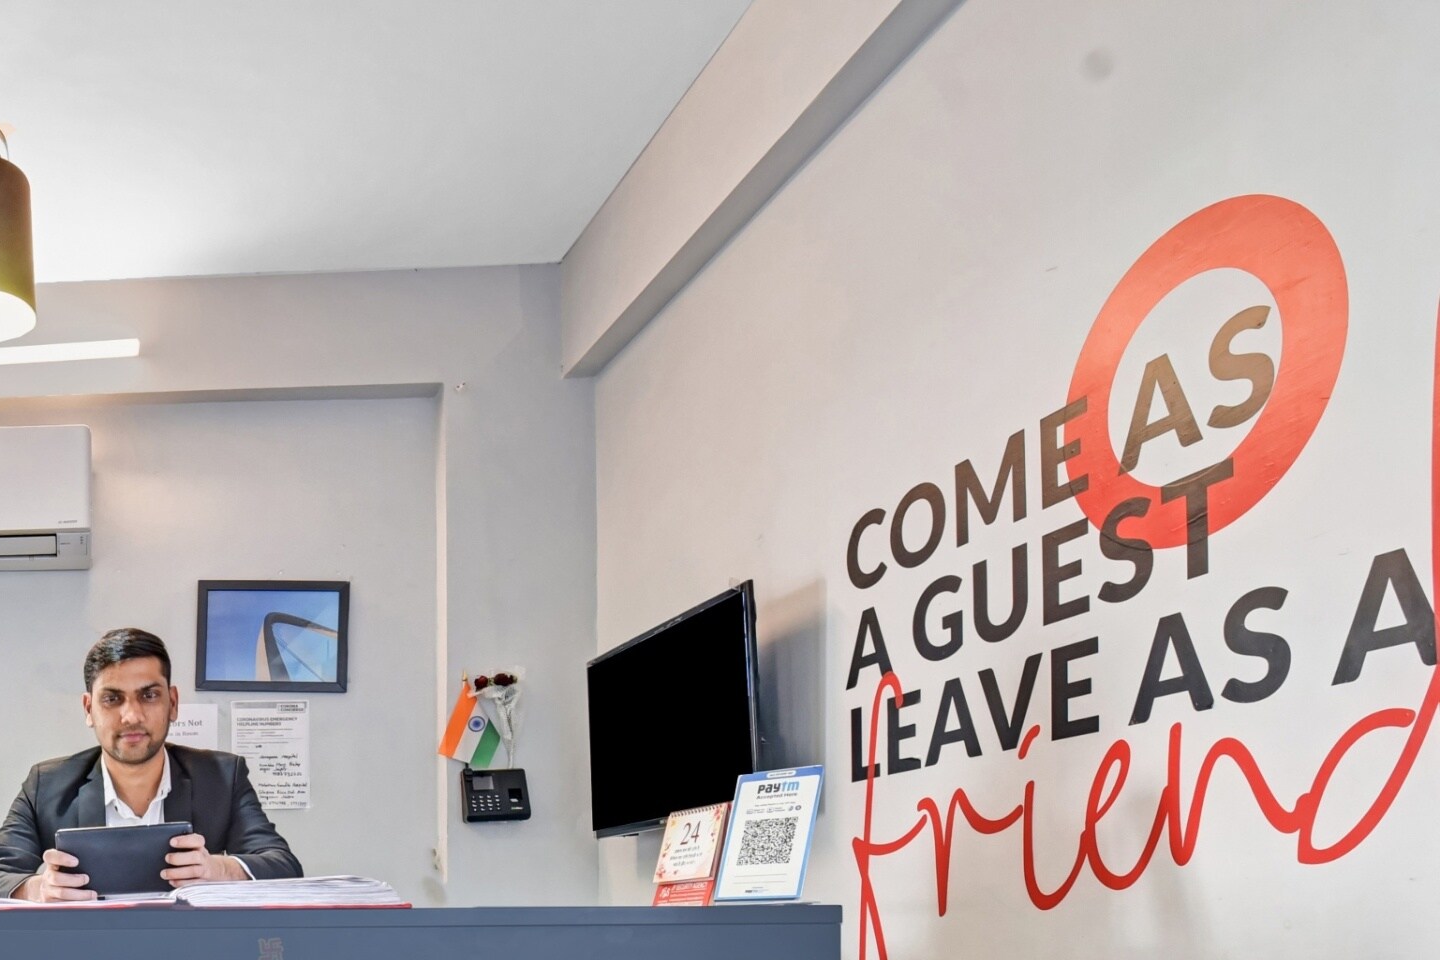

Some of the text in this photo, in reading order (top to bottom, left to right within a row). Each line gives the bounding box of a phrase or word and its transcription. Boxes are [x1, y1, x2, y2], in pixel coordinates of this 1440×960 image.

[846, 305, 1275, 589] COME AS
[846, 457, 1235, 690] A GUEST
[850, 548, 1438, 783] LEAVE AS A
[188, 719, 203, 727] Not
[679, 820, 701, 846] 24
